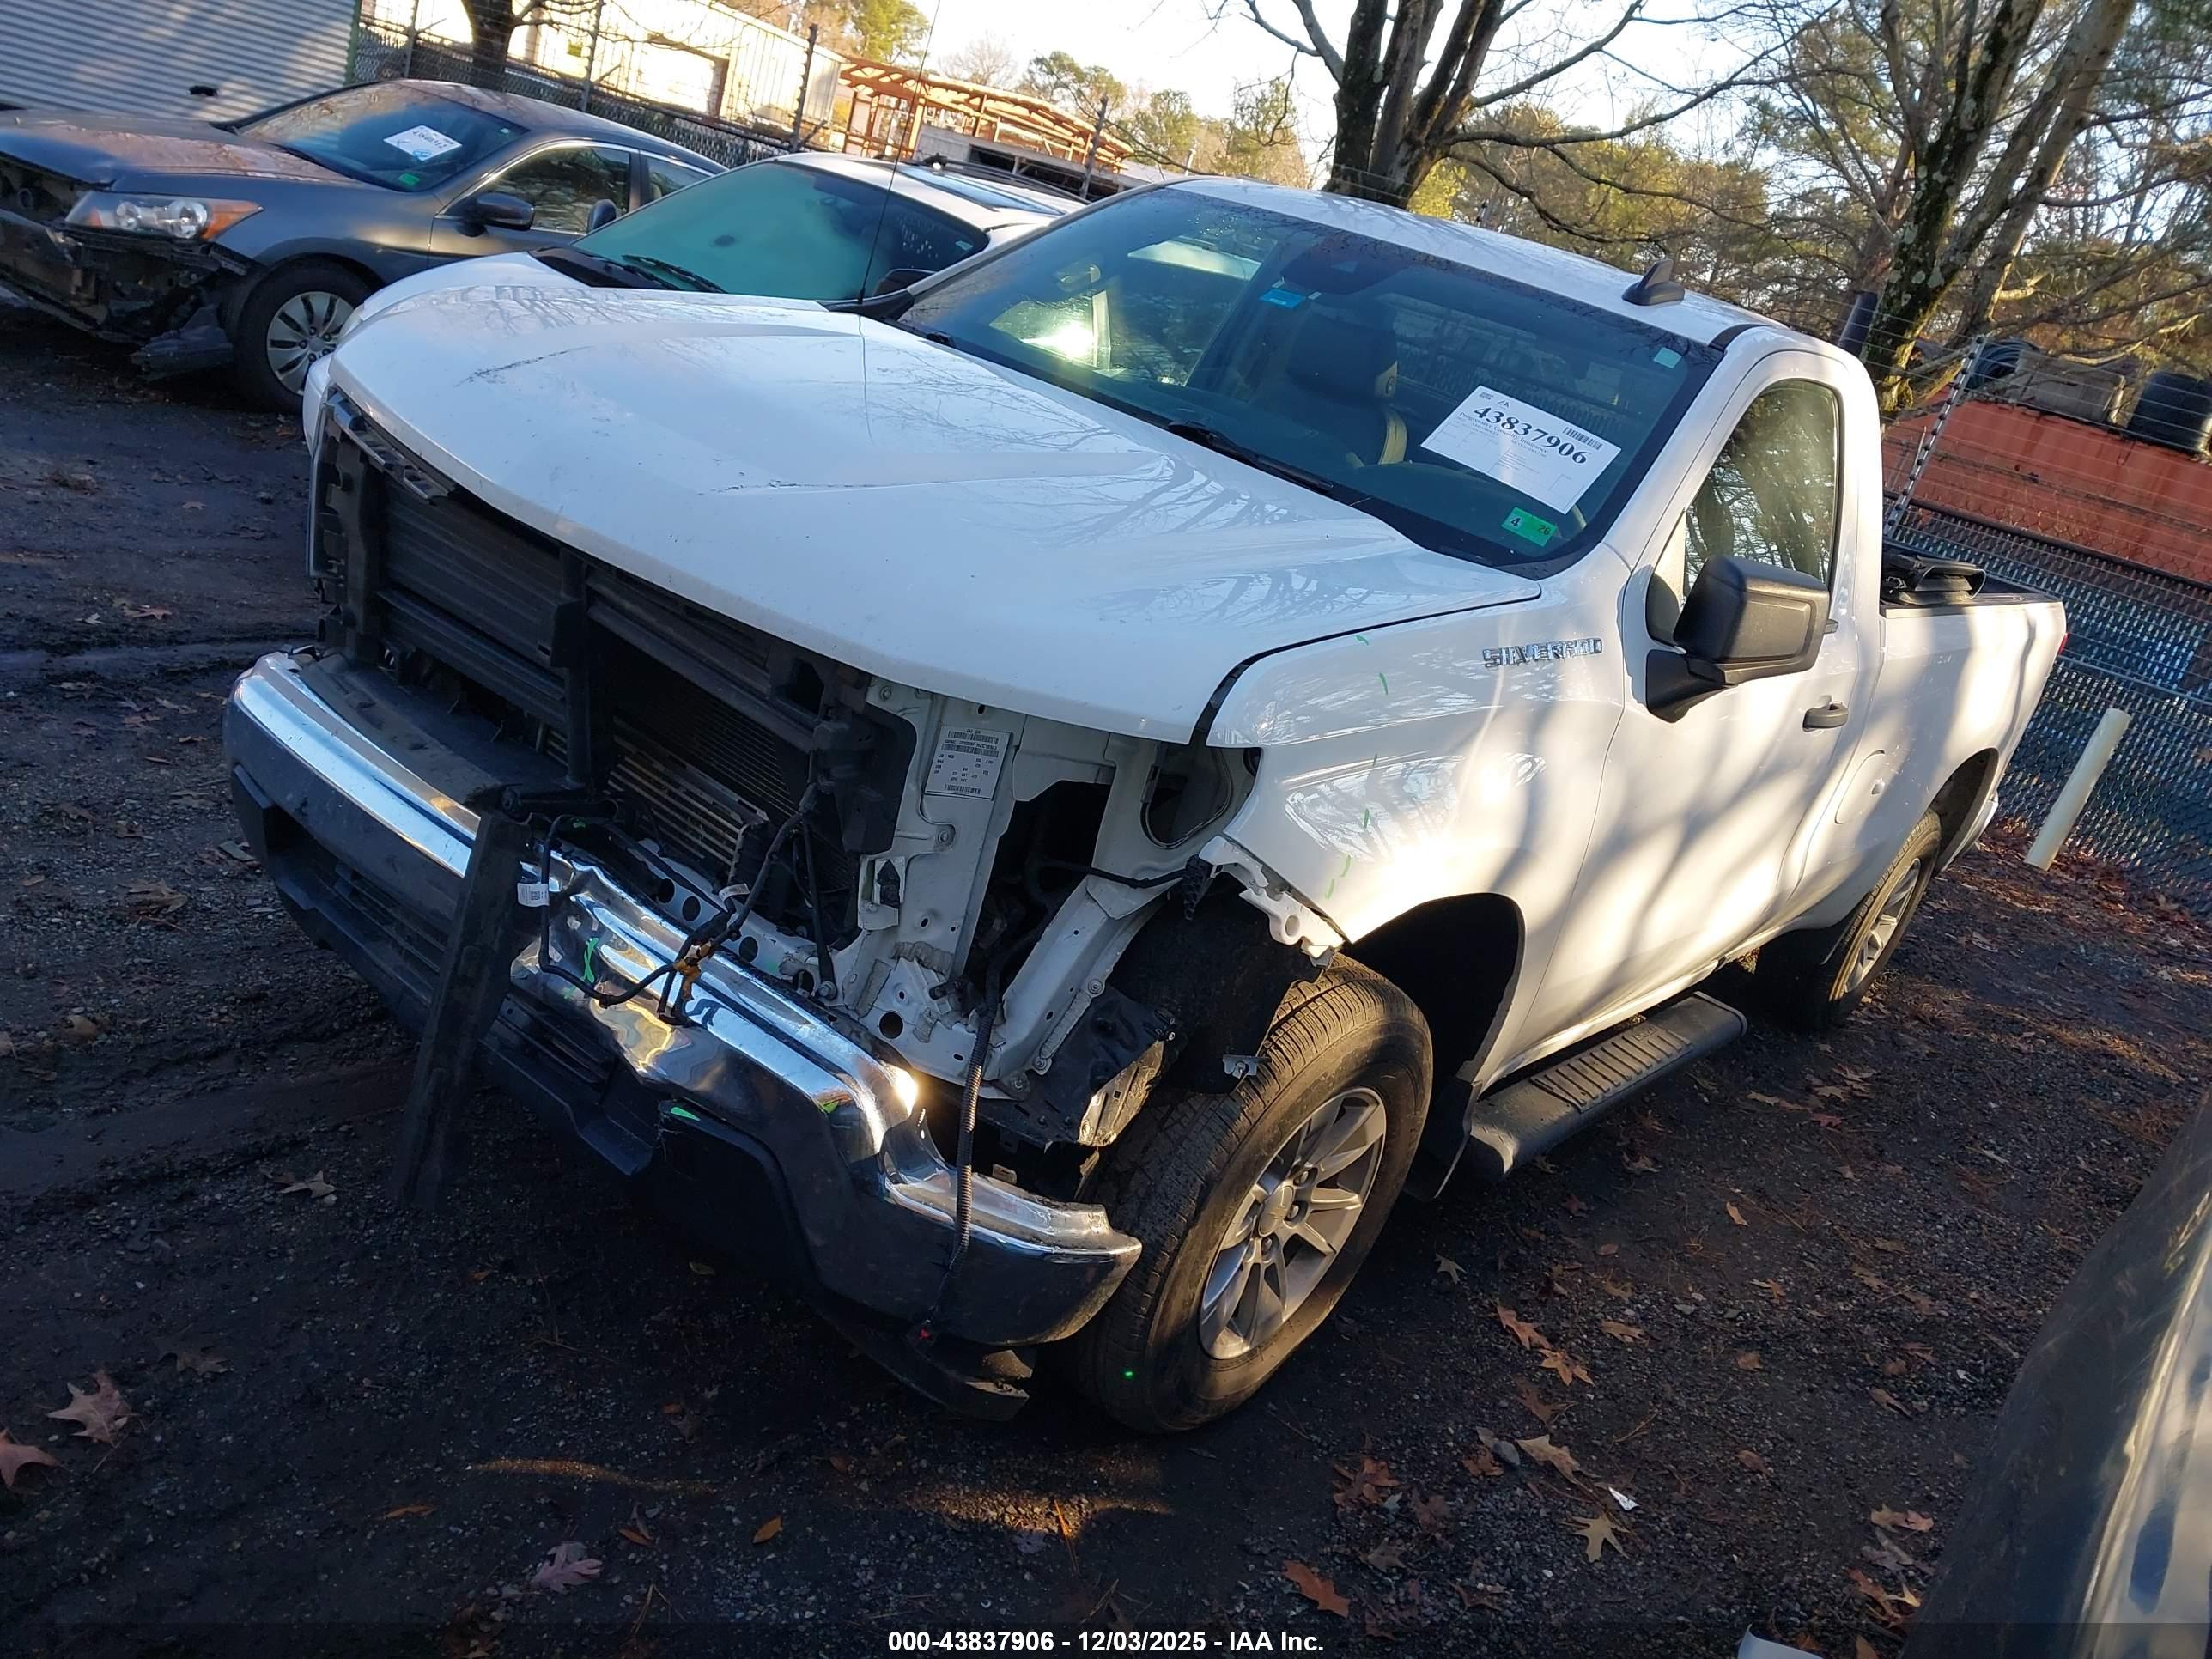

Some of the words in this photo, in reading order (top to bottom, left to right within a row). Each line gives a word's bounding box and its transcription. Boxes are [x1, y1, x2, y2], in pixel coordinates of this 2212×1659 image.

[1474, 407, 1592, 464] 43837906
[1510, 517, 1520, 527] 4
[1537, 524, 1551, 536] 26
[1483, 638, 1602, 668] SILVERADO
